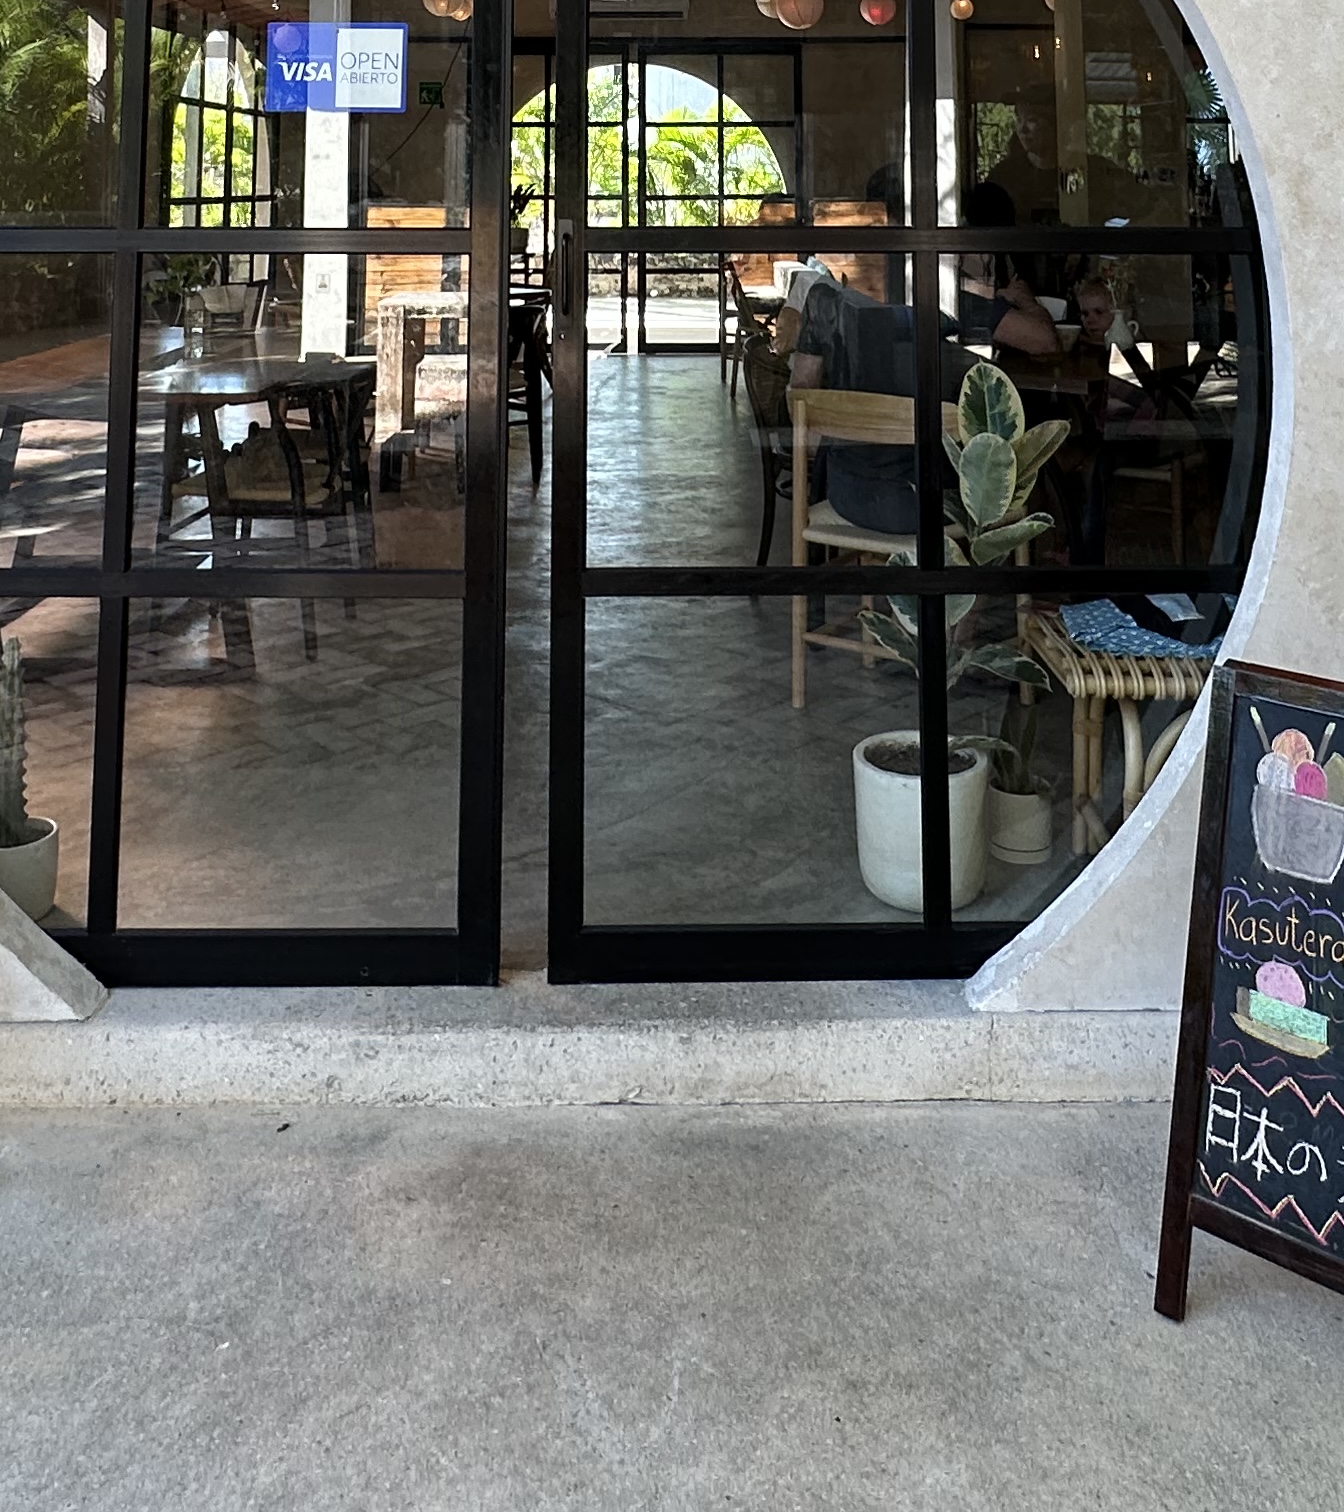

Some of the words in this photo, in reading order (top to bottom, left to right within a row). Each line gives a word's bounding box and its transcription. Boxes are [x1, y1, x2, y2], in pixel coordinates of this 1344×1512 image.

[340, 52, 399, 70] OPEN
[280, 61, 333, 81] VISA
[339, 72, 398, 84] ABIERTO
